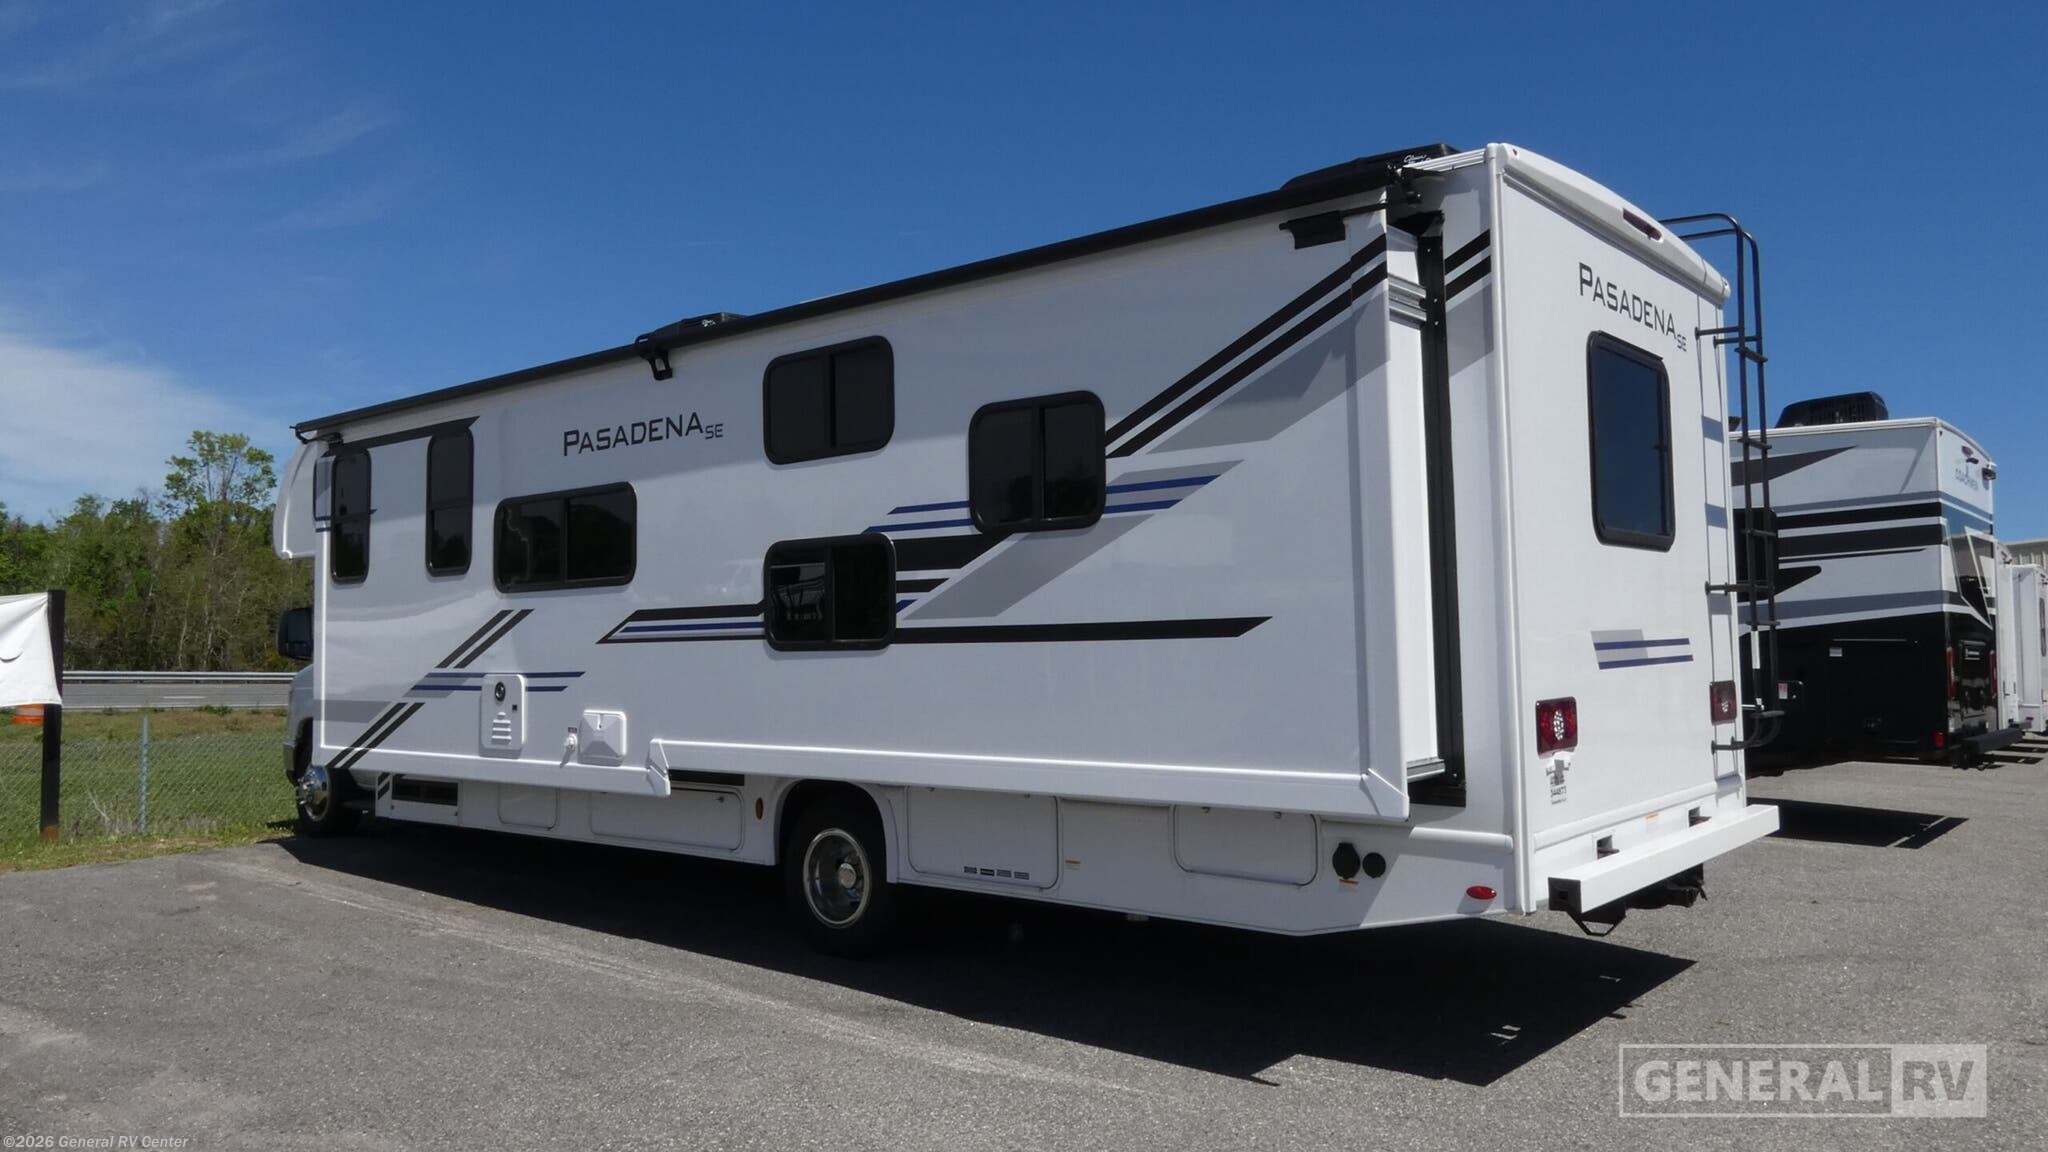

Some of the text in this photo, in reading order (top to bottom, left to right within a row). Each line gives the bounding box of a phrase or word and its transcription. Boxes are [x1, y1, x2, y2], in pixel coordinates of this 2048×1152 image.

[1579, 262, 1687, 352] PASADENA SE
[563, 412, 724, 456] PASADENA SE
